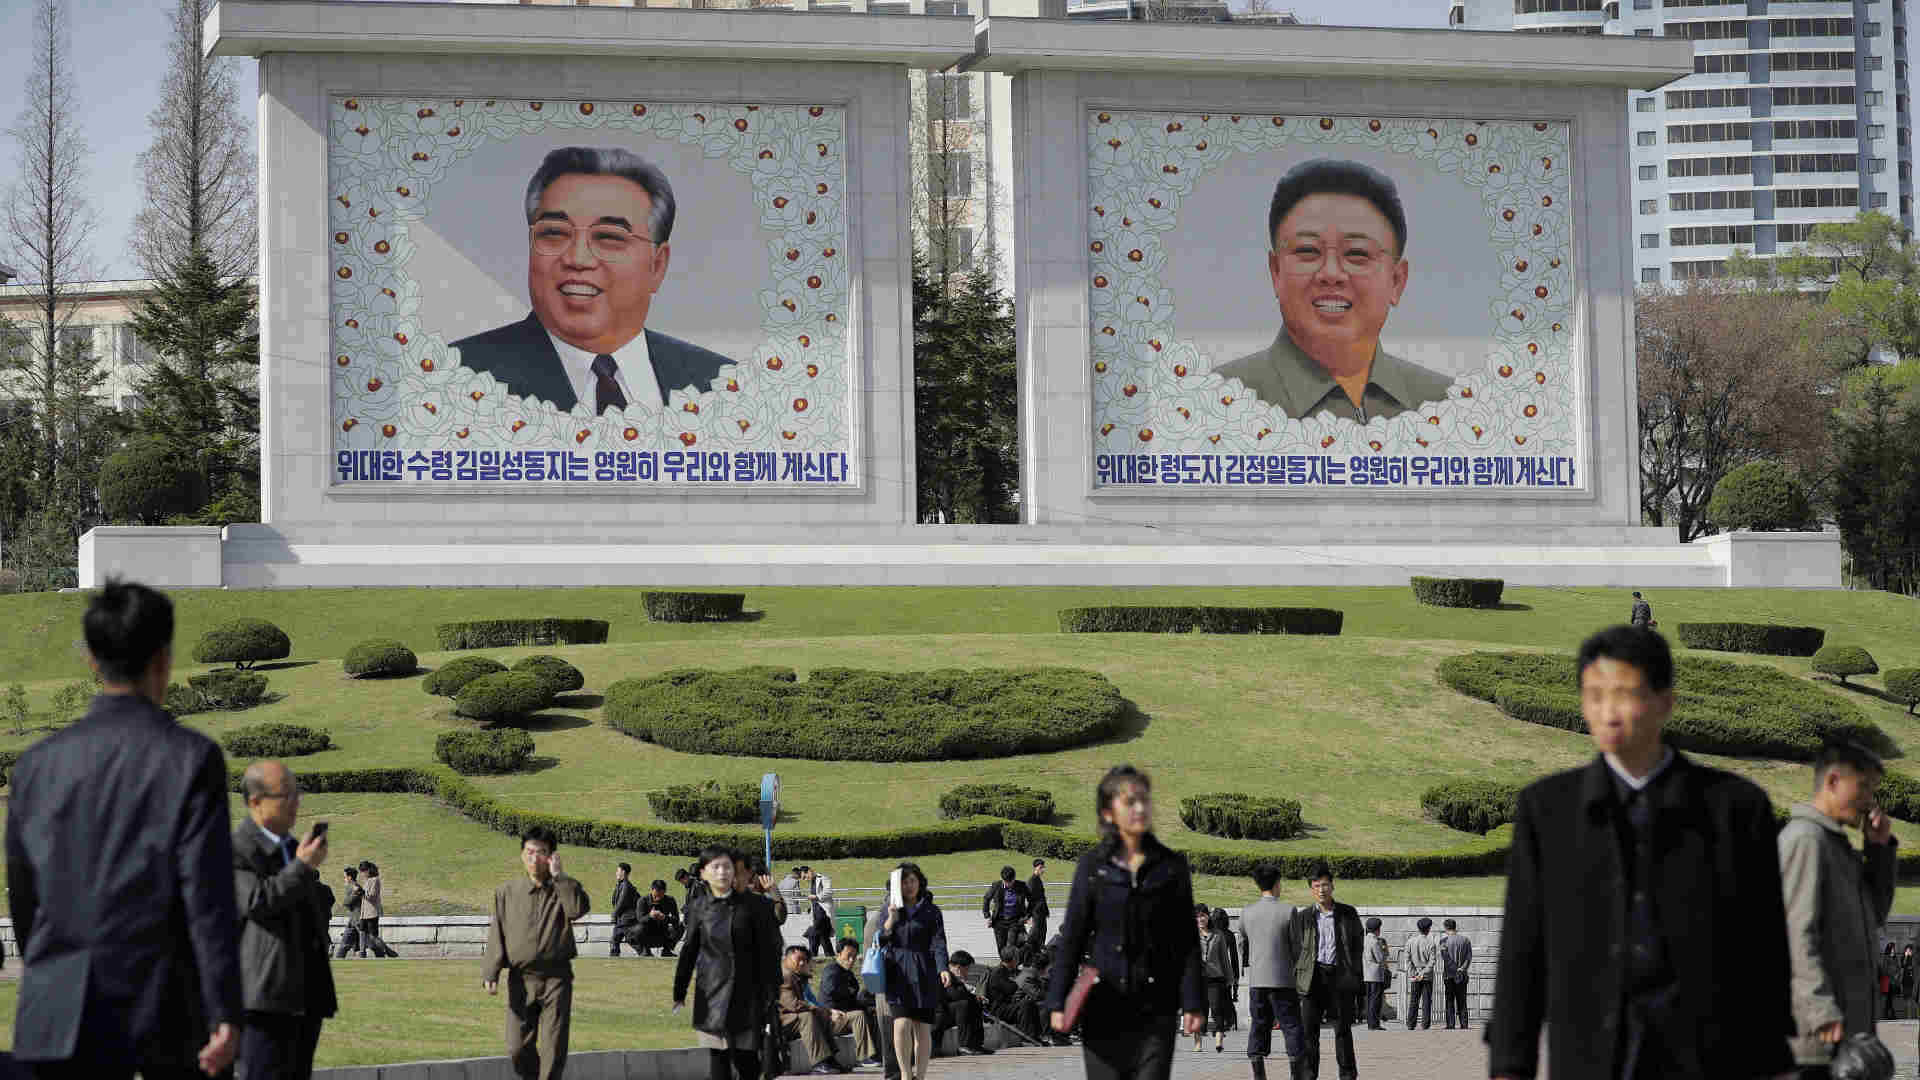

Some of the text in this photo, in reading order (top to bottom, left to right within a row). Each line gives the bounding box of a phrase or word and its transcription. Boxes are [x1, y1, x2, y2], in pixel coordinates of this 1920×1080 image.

[335, 450, 849, 481] 위대한 수령 김일성동지는 영원히 우리와 함께 계신다
[1096, 455, 1576, 485] 위대한 령도자 김정일동지는 영원히 우리와 함께 계신다
